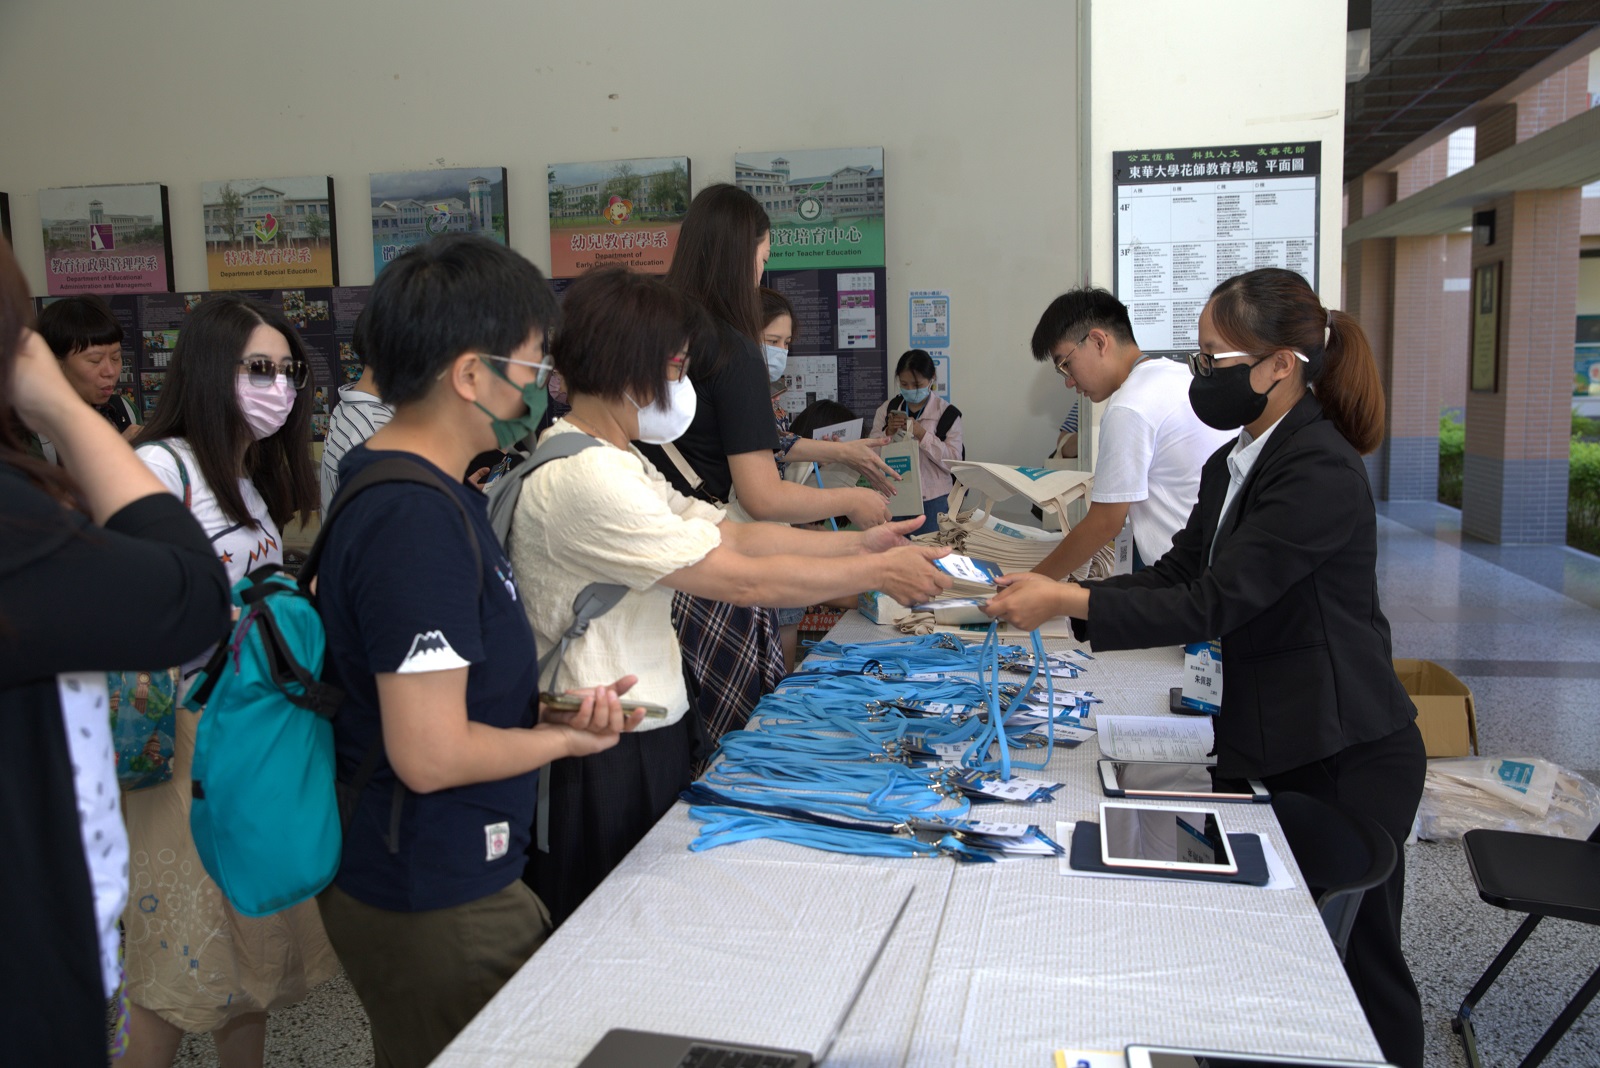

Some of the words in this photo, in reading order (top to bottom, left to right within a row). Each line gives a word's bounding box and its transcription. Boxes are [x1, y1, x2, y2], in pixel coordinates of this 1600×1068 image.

[1192, 149, 1241, 159] 科技人文
[1257, 145, 1306, 157] 友善花師
[1128, 160, 1258, 178] 東華大學花師教育學院
[1265, 157, 1305, 173] 平面圖
[1119, 203, 1130, 211] 4F
[571, 231, 668, 251] 幼兒教育學系
[224, 246, 312, 267] 特殊教育學系
[595, 252, 634, 260] Department
[796, 249, 824, 257] Teacher
[826, 248, 862, 256] Education
[1120, 248, 1131, 256] 3F
[51, 255, 159, 275] 教育行政與管理學系
[576, 261, 593, 269] Early
[220, 270, 255, 278] Department
[263, 268, 286, 276] Special
[287, 267, 318, 275] Education
